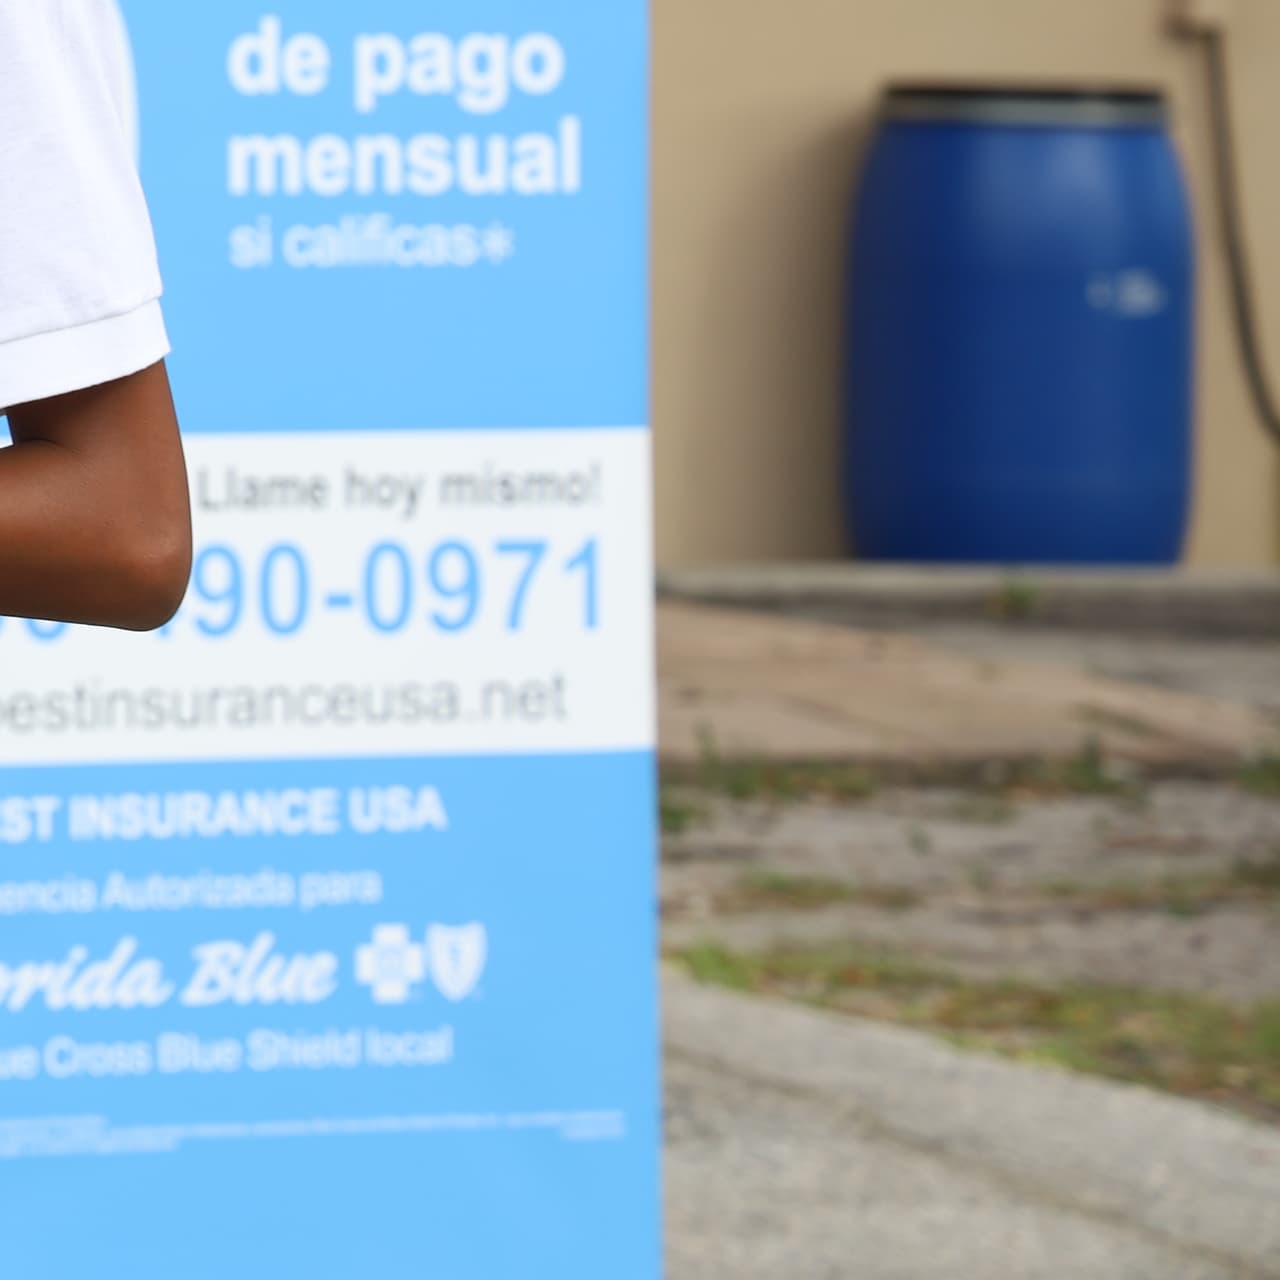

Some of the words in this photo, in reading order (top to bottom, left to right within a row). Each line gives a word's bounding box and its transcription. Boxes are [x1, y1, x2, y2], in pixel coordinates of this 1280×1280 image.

[226, 15, 332, 96] de
[352, 31, 567, 115] pago
[226, 114, 583, 197] mensual
[228, 213, 273, 268] si
[197, 468, 330, 512] Llame
[344, 468, 427, 520] hoy
[439, 462, 603, 506] mismo!
[69, 787, 340, 840] INSURANCE
[348, 785, 448, 835] USA
[101, 868, 294, 912] Autorizada
[298, 870, 383, 912] para
[179, 931, 340, 1008] Blue
[43, 1034, 152, 1079] Cross
[156, 1030, 241, 1075] Blue
[245, 1026, 363, 1072] Shield
[367, 1024, 454, 1067] local
